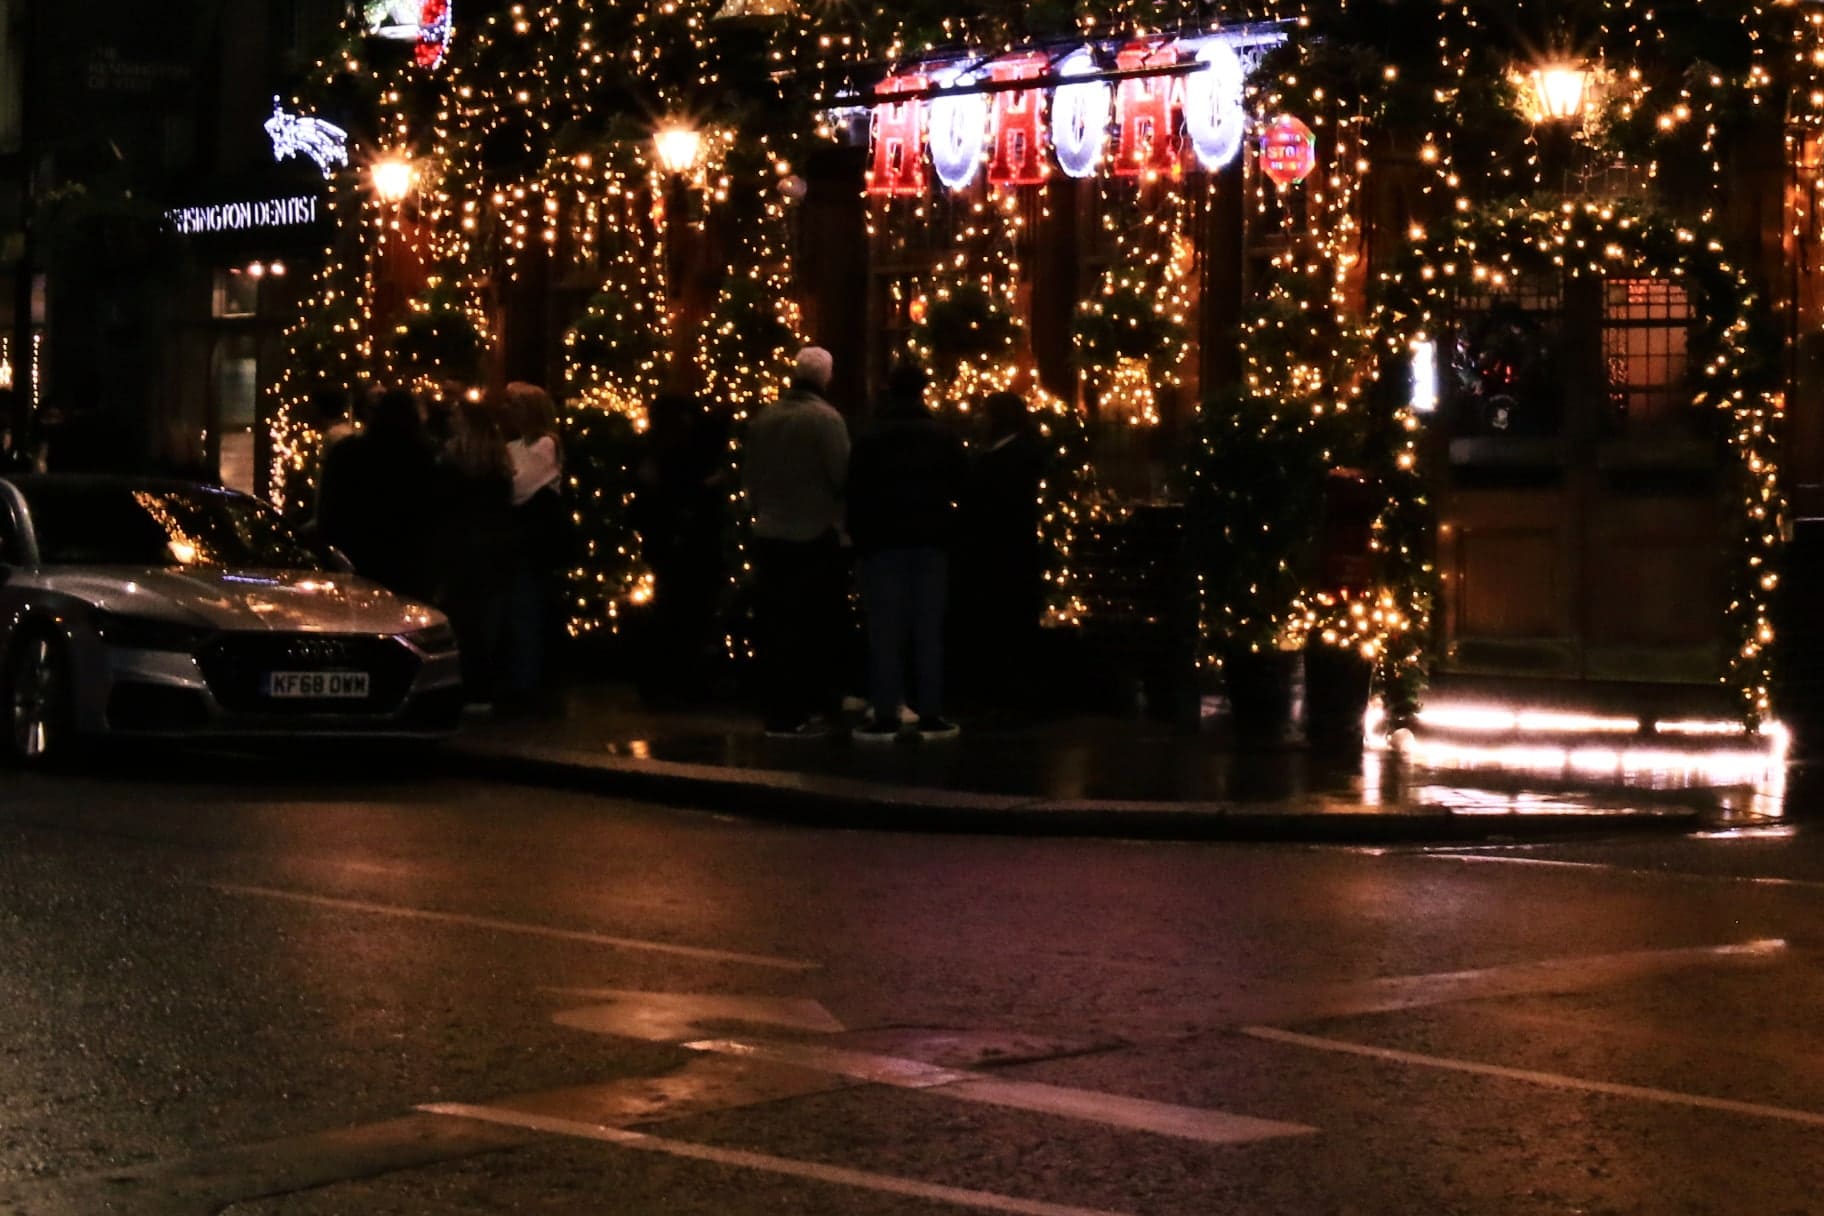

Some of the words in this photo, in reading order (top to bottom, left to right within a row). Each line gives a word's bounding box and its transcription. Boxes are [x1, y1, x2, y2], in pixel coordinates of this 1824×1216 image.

[161, 202, 251, 234] NSINGTON
[254, 194, 318, 227] DENTIST
[273, 674, 323, 694] KF68
